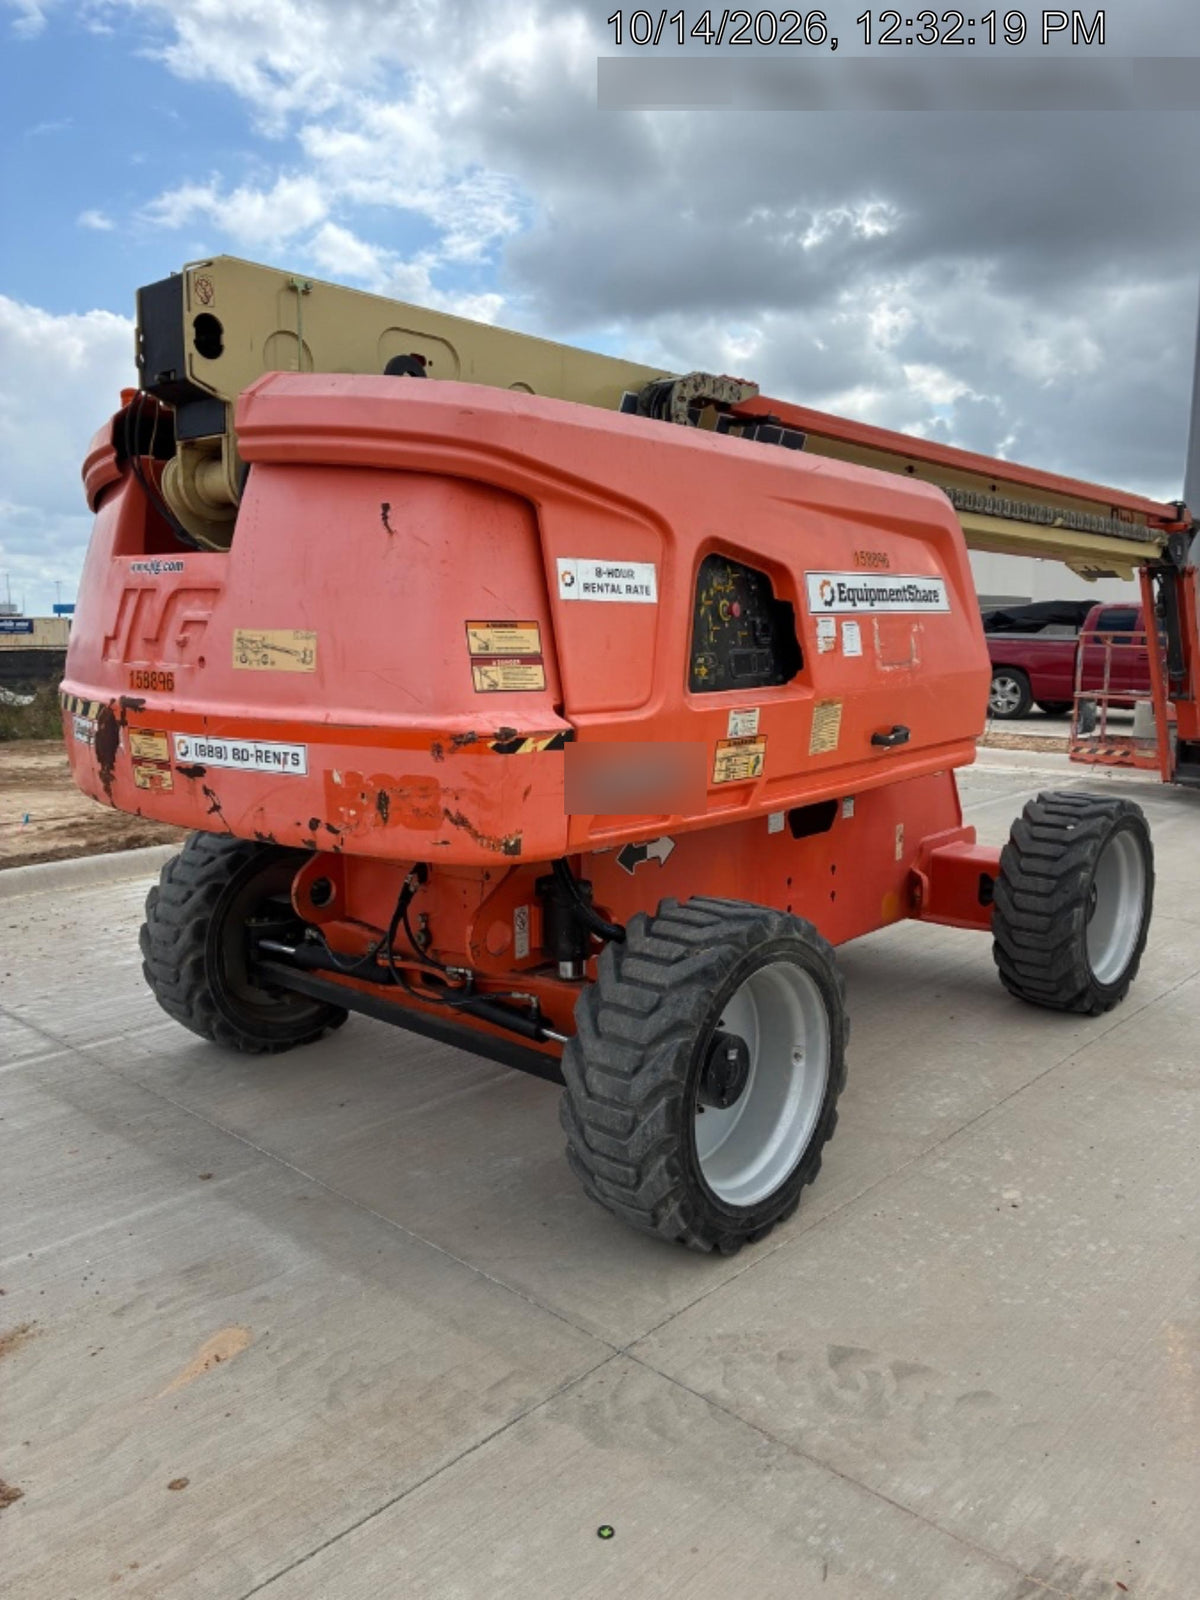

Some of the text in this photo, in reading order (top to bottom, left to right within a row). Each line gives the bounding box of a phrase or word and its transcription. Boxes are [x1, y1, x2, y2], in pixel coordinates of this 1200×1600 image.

[595, 566, 636, 580] 8-HOUR
[582, 582, 651, 597] RENTAL RATE
[837, 582, 940, 607] EquipmentShare
[129, 669, 176, 693] 158896
[194, 742, 229, 761] (888)
